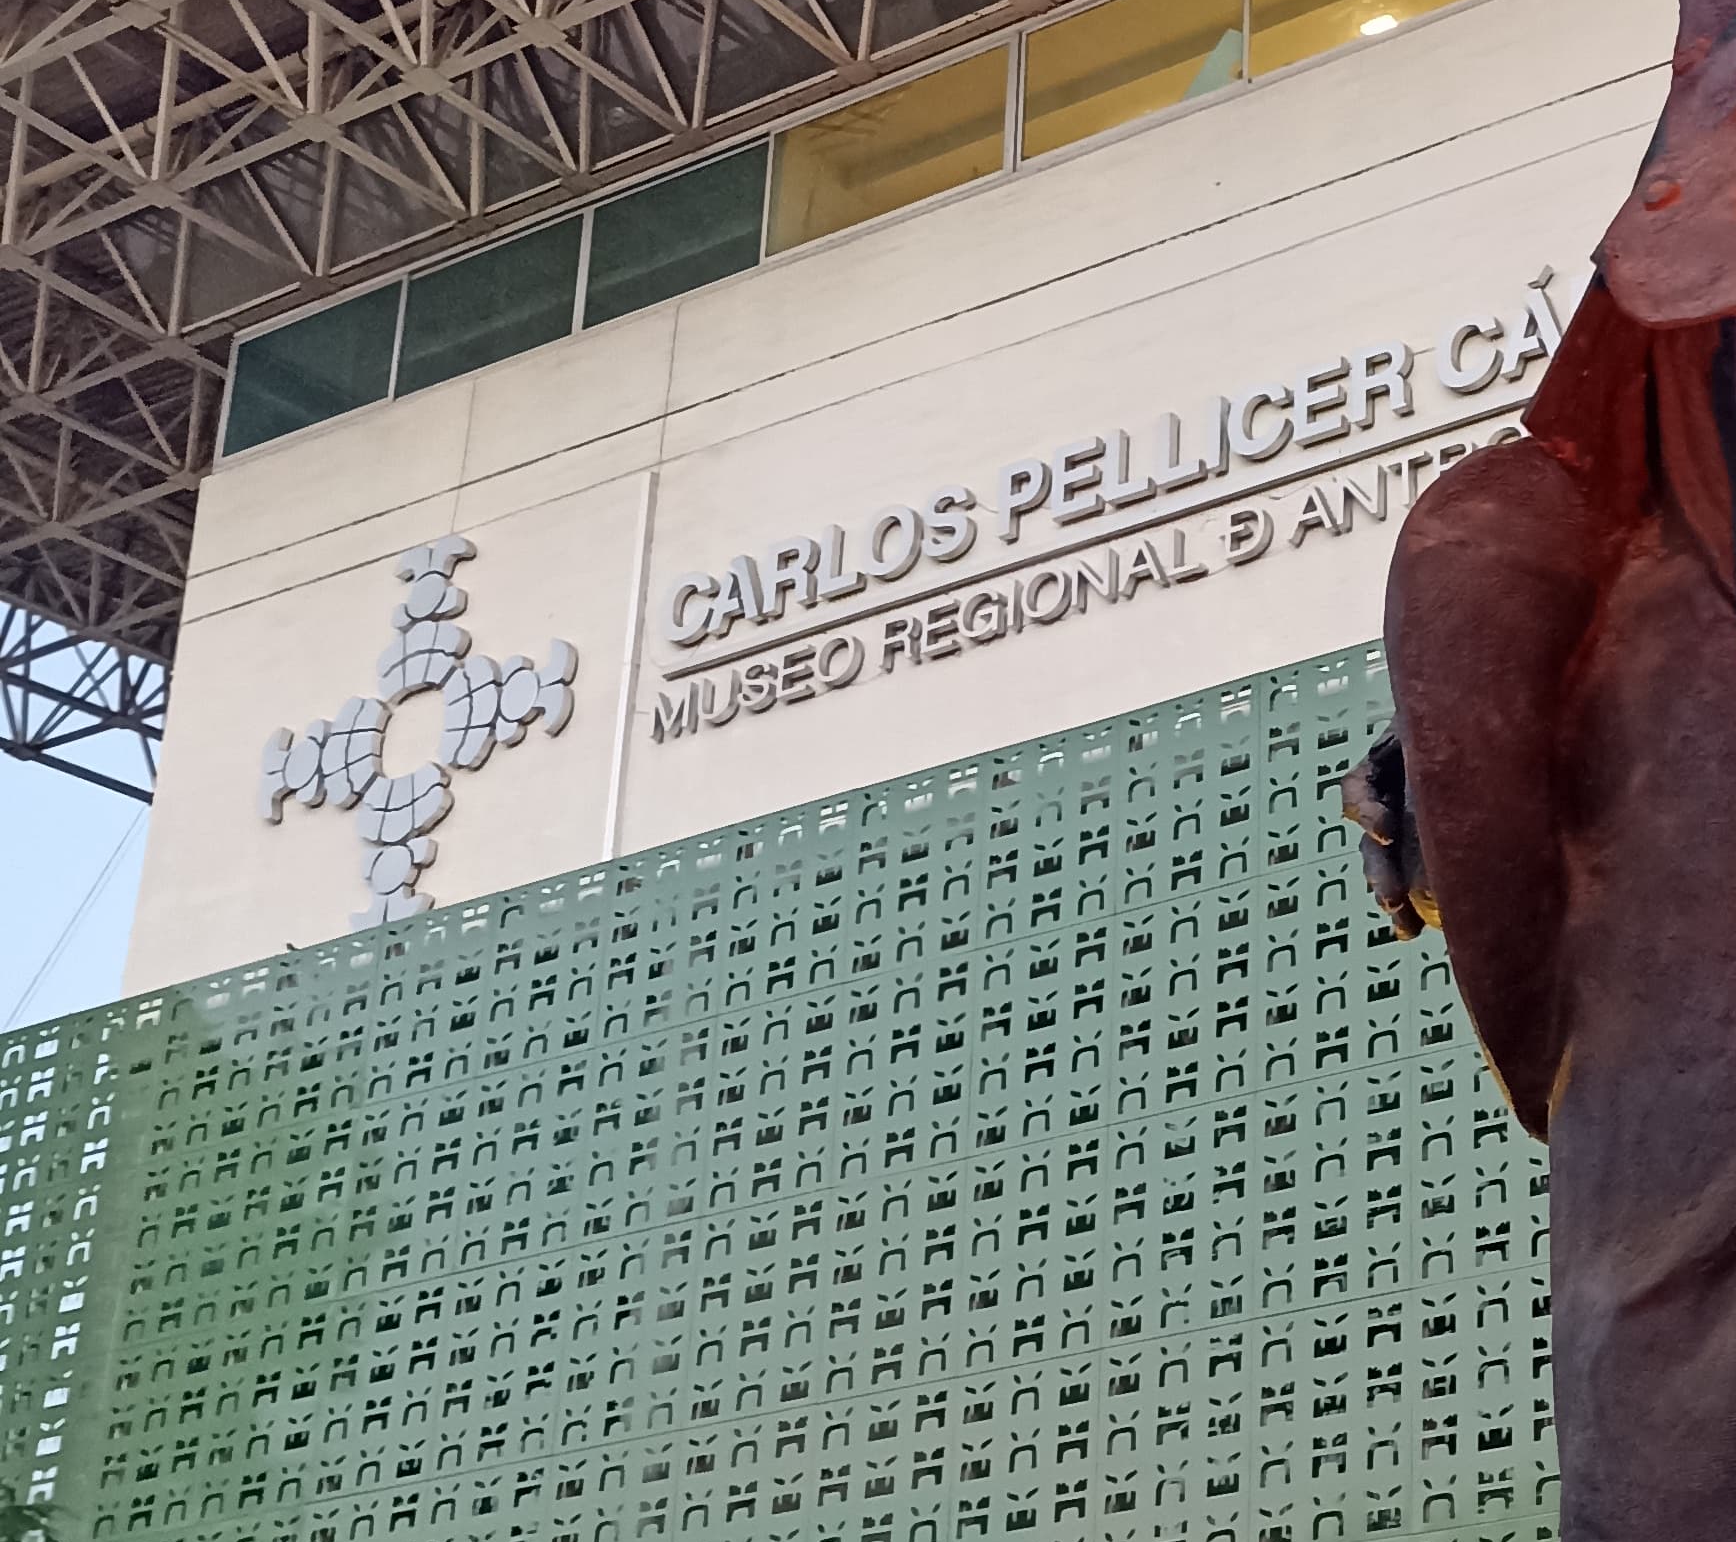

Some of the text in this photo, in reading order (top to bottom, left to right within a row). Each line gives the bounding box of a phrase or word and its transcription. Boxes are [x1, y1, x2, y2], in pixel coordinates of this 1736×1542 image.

[650, 633, 865, 744] MUSEO
[880, 529, 1209, 674] REGIONAL
[1289, 426, 1524, 548] ANT
[660, 264, 1592, 647] CARLOS PELLICER CÁ
